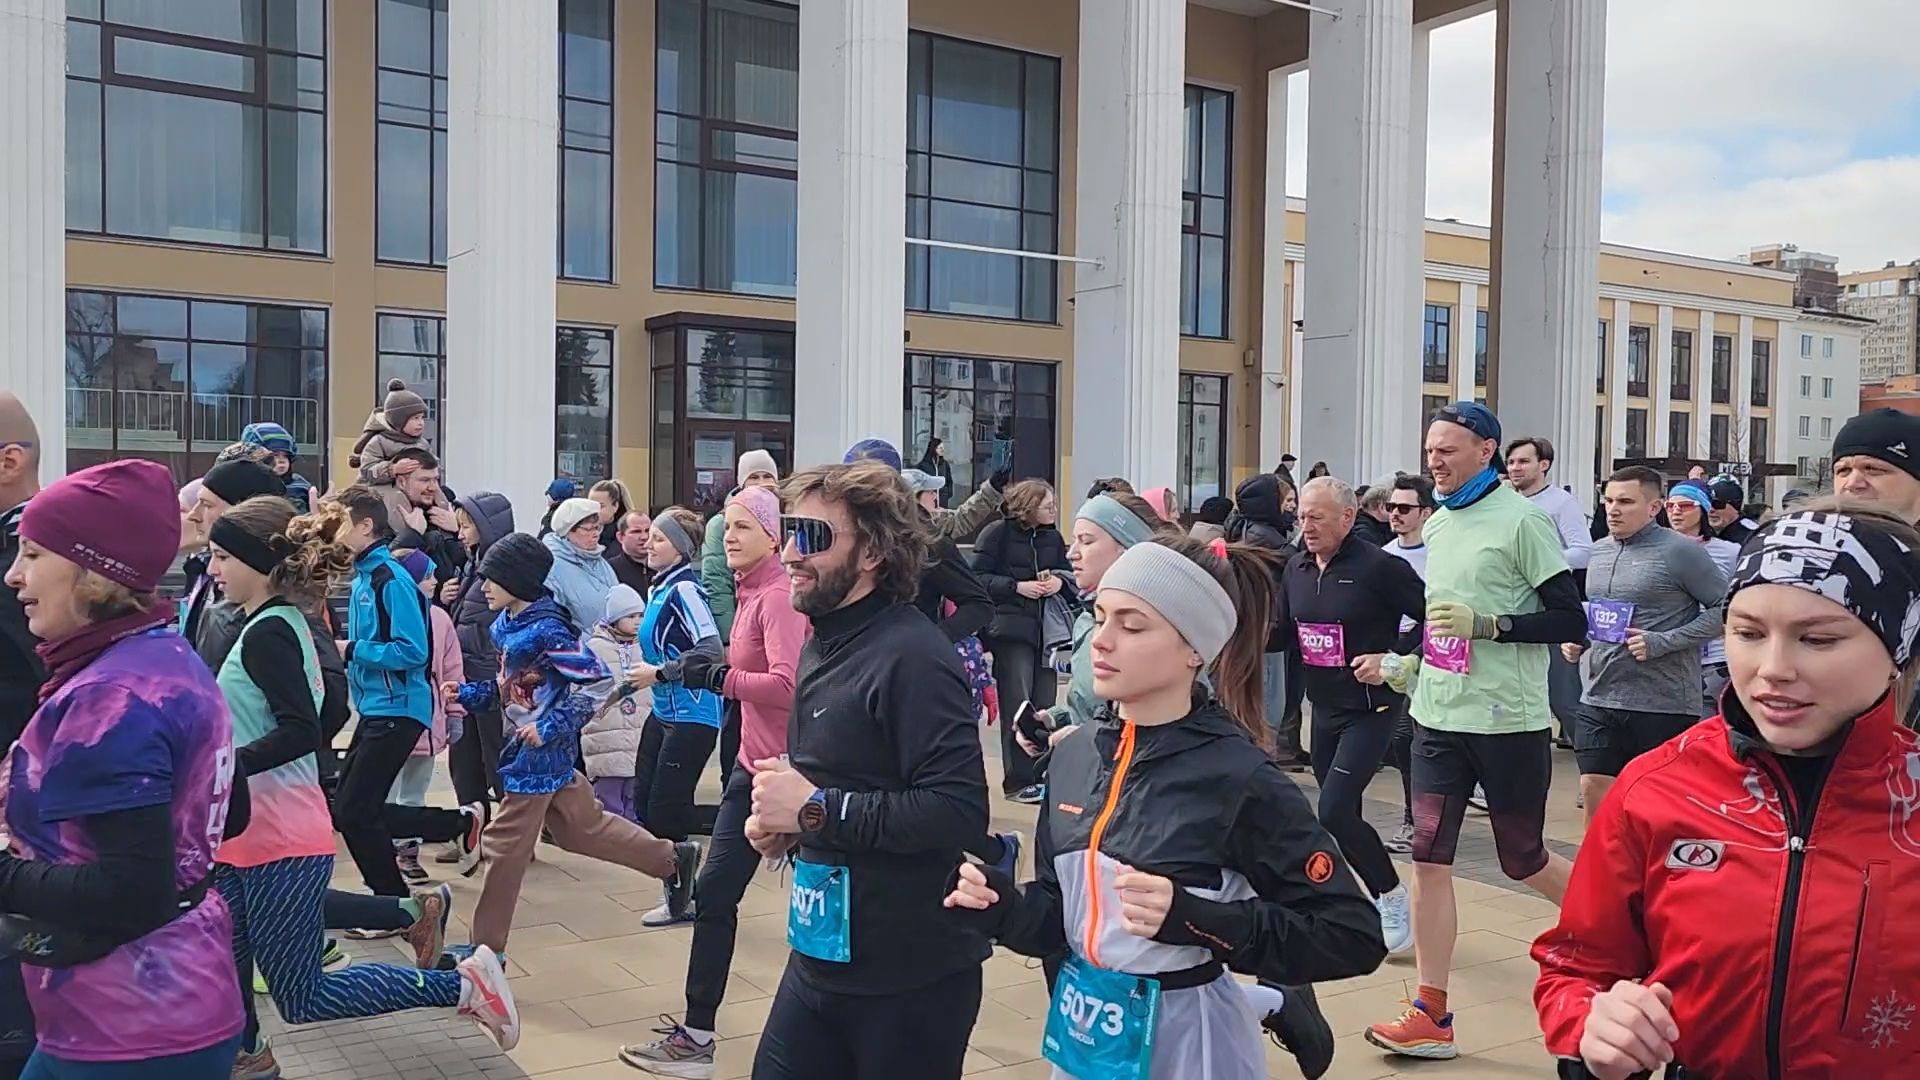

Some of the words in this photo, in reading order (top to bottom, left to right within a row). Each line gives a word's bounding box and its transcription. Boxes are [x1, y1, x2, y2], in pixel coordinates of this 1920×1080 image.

[1594, 610, 1619, 625] 1312
[1302, 633, 1334, 648] 2078
[1059, 984, 1125, 1037] 5073
